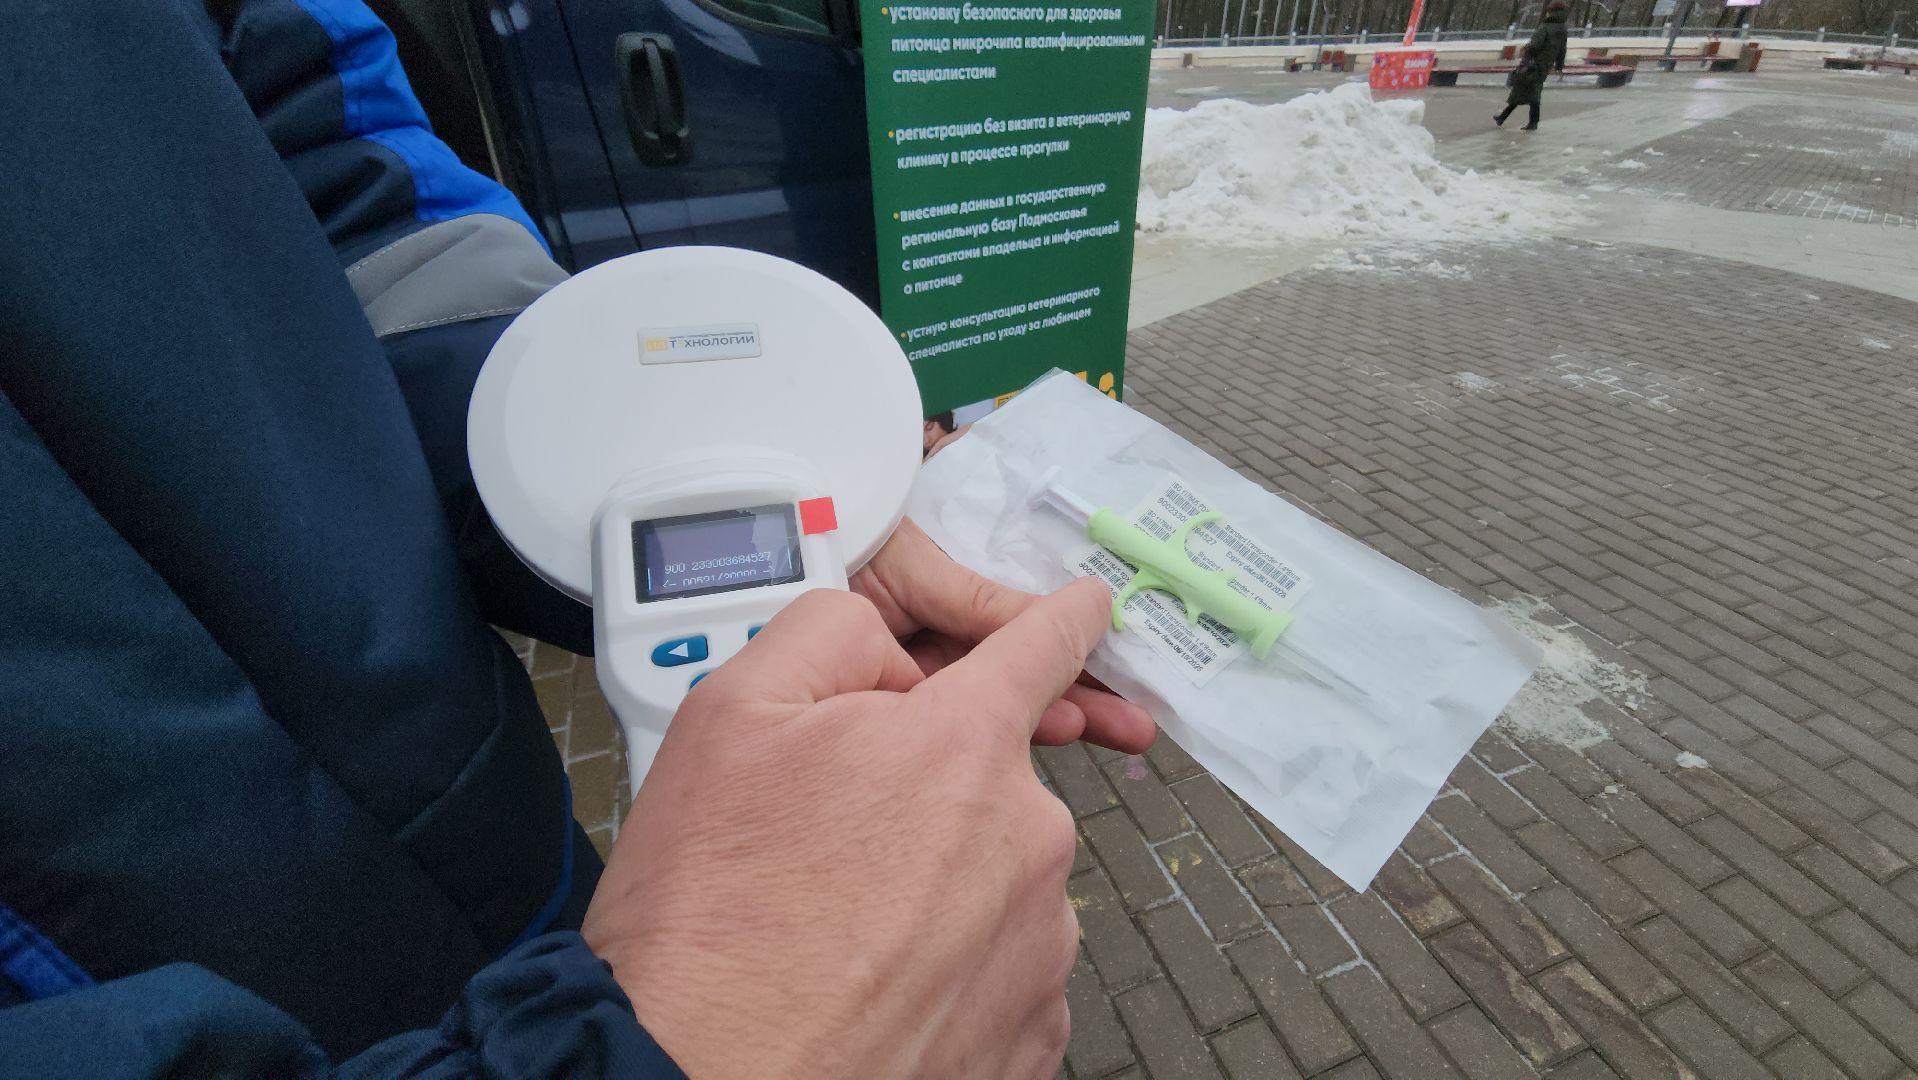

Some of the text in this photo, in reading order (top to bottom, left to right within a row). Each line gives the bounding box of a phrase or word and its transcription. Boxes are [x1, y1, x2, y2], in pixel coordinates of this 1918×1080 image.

[890, 3, 1121, 24] установку безопасного для здоровья
[891, 32, 1145, 53] питомца микрочипа квалифицированными
[893, 66, 996, 84] специалистами
[896, 110, 1131, 144] регистрацию без визита в ветеринарную
[898, 140, 1069, 169] клинику в процессе прогулки
[900, 183, 1106, 222] внесение данных в государственную
[901, 207, 1087, 250] региональную базу Подмосковья
[902, 220, 1120, 272] с контактами владельца и информацией
[904, 273, 963, 295] о питомце
[907, 286, 1100, 342] устную консультацию ветеринарного
[909, 308, 1091, 361] специалиста по уходу за любимцем
[1224, 524, 1247, 544] Standard
[1246, 540, 1279, 567] transponder
[1225, 550, 1244, 568] Expiry
[664, 563, 685, 575] 900
[1144, 619, 1162, 637] Expiry
